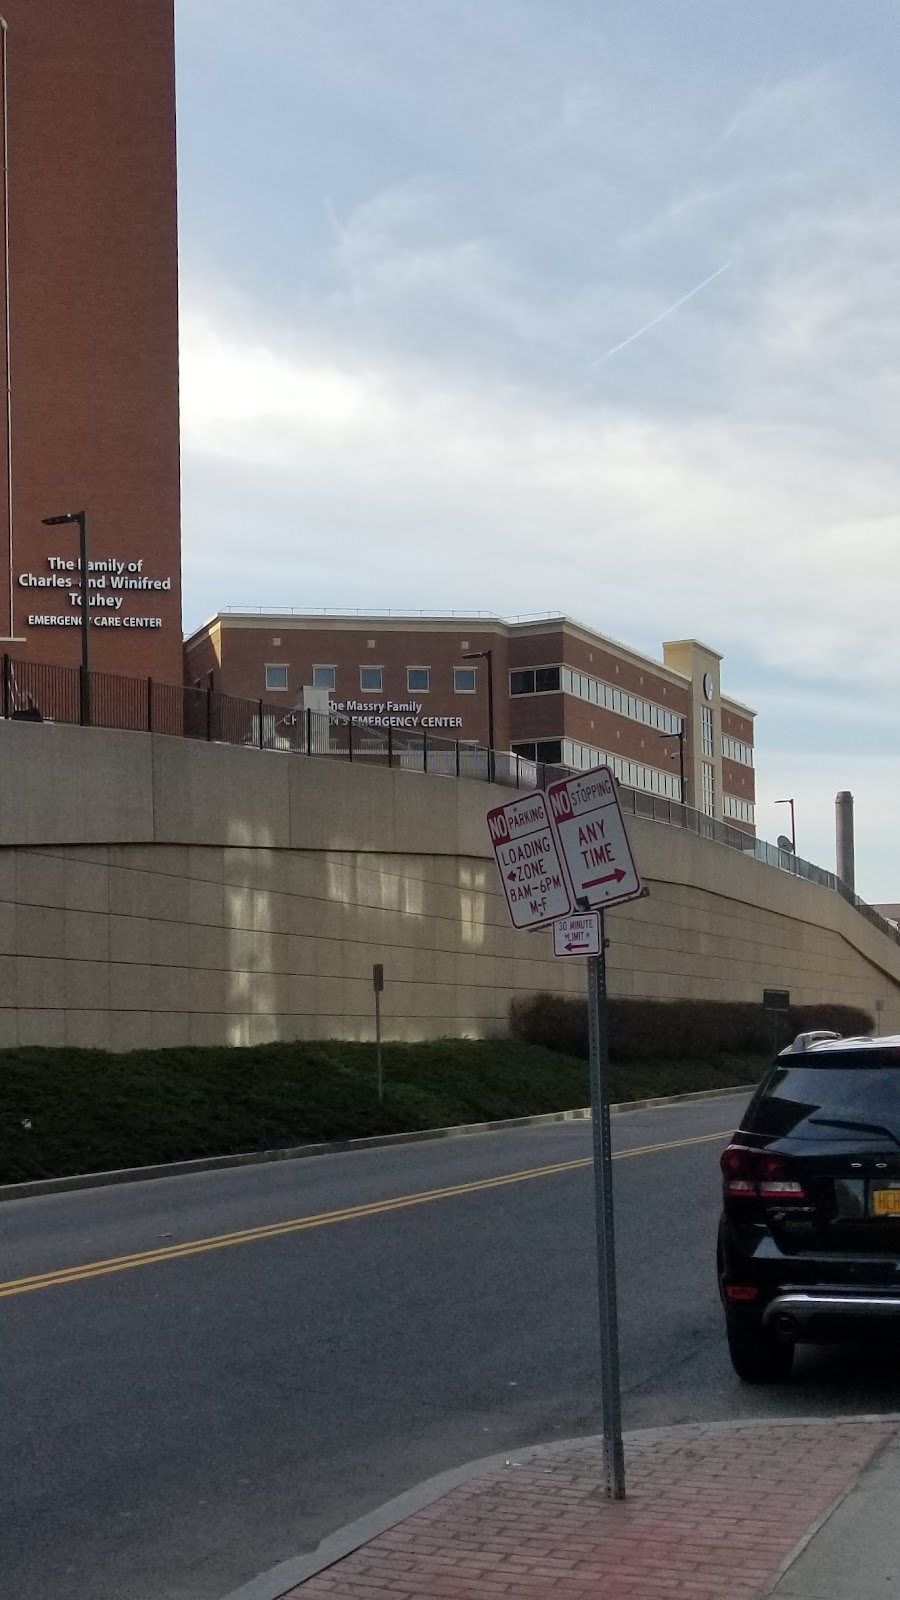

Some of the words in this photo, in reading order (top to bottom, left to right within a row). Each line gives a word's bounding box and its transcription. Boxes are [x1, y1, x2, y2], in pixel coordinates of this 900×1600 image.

[48, 557, 74, 570] The
[128, 559, 143, 573] of
[19, 573, 72, 588] Charles
[111, 576, 171, 590] Winifred
[28, 615, 91, 627] EMERGENC
[94, 616, 121, 627] CARE
[123, 616, 162, 628] CENTER
[346, 700, 385, 714] Massry
[387, 701, 423, 715] Family
[351, 716, 417, 728] EMERGENCY
[420, 716, 463, 728] CENTER
[550, 790, 572, 818] NO
[570, 779, 612, 807] STOPPING
[488, 814, 508, 840] NO
[508, 806, 544, 830] PARKING
[578, 819, 606, 847] ANY
[501, 836, 551, 867] LOADING
[581, 842, 616, 869] TIME
[516, 858, 547, 882] ZONE
[510, 874, 561, 903] 8AM-6PM
[529, 896, 547, 915] M-F
[559, 921, 568, 931] 30
[569, 919, 593, 931] MINUTE
[567, 931, 584, 942] LIMIT
